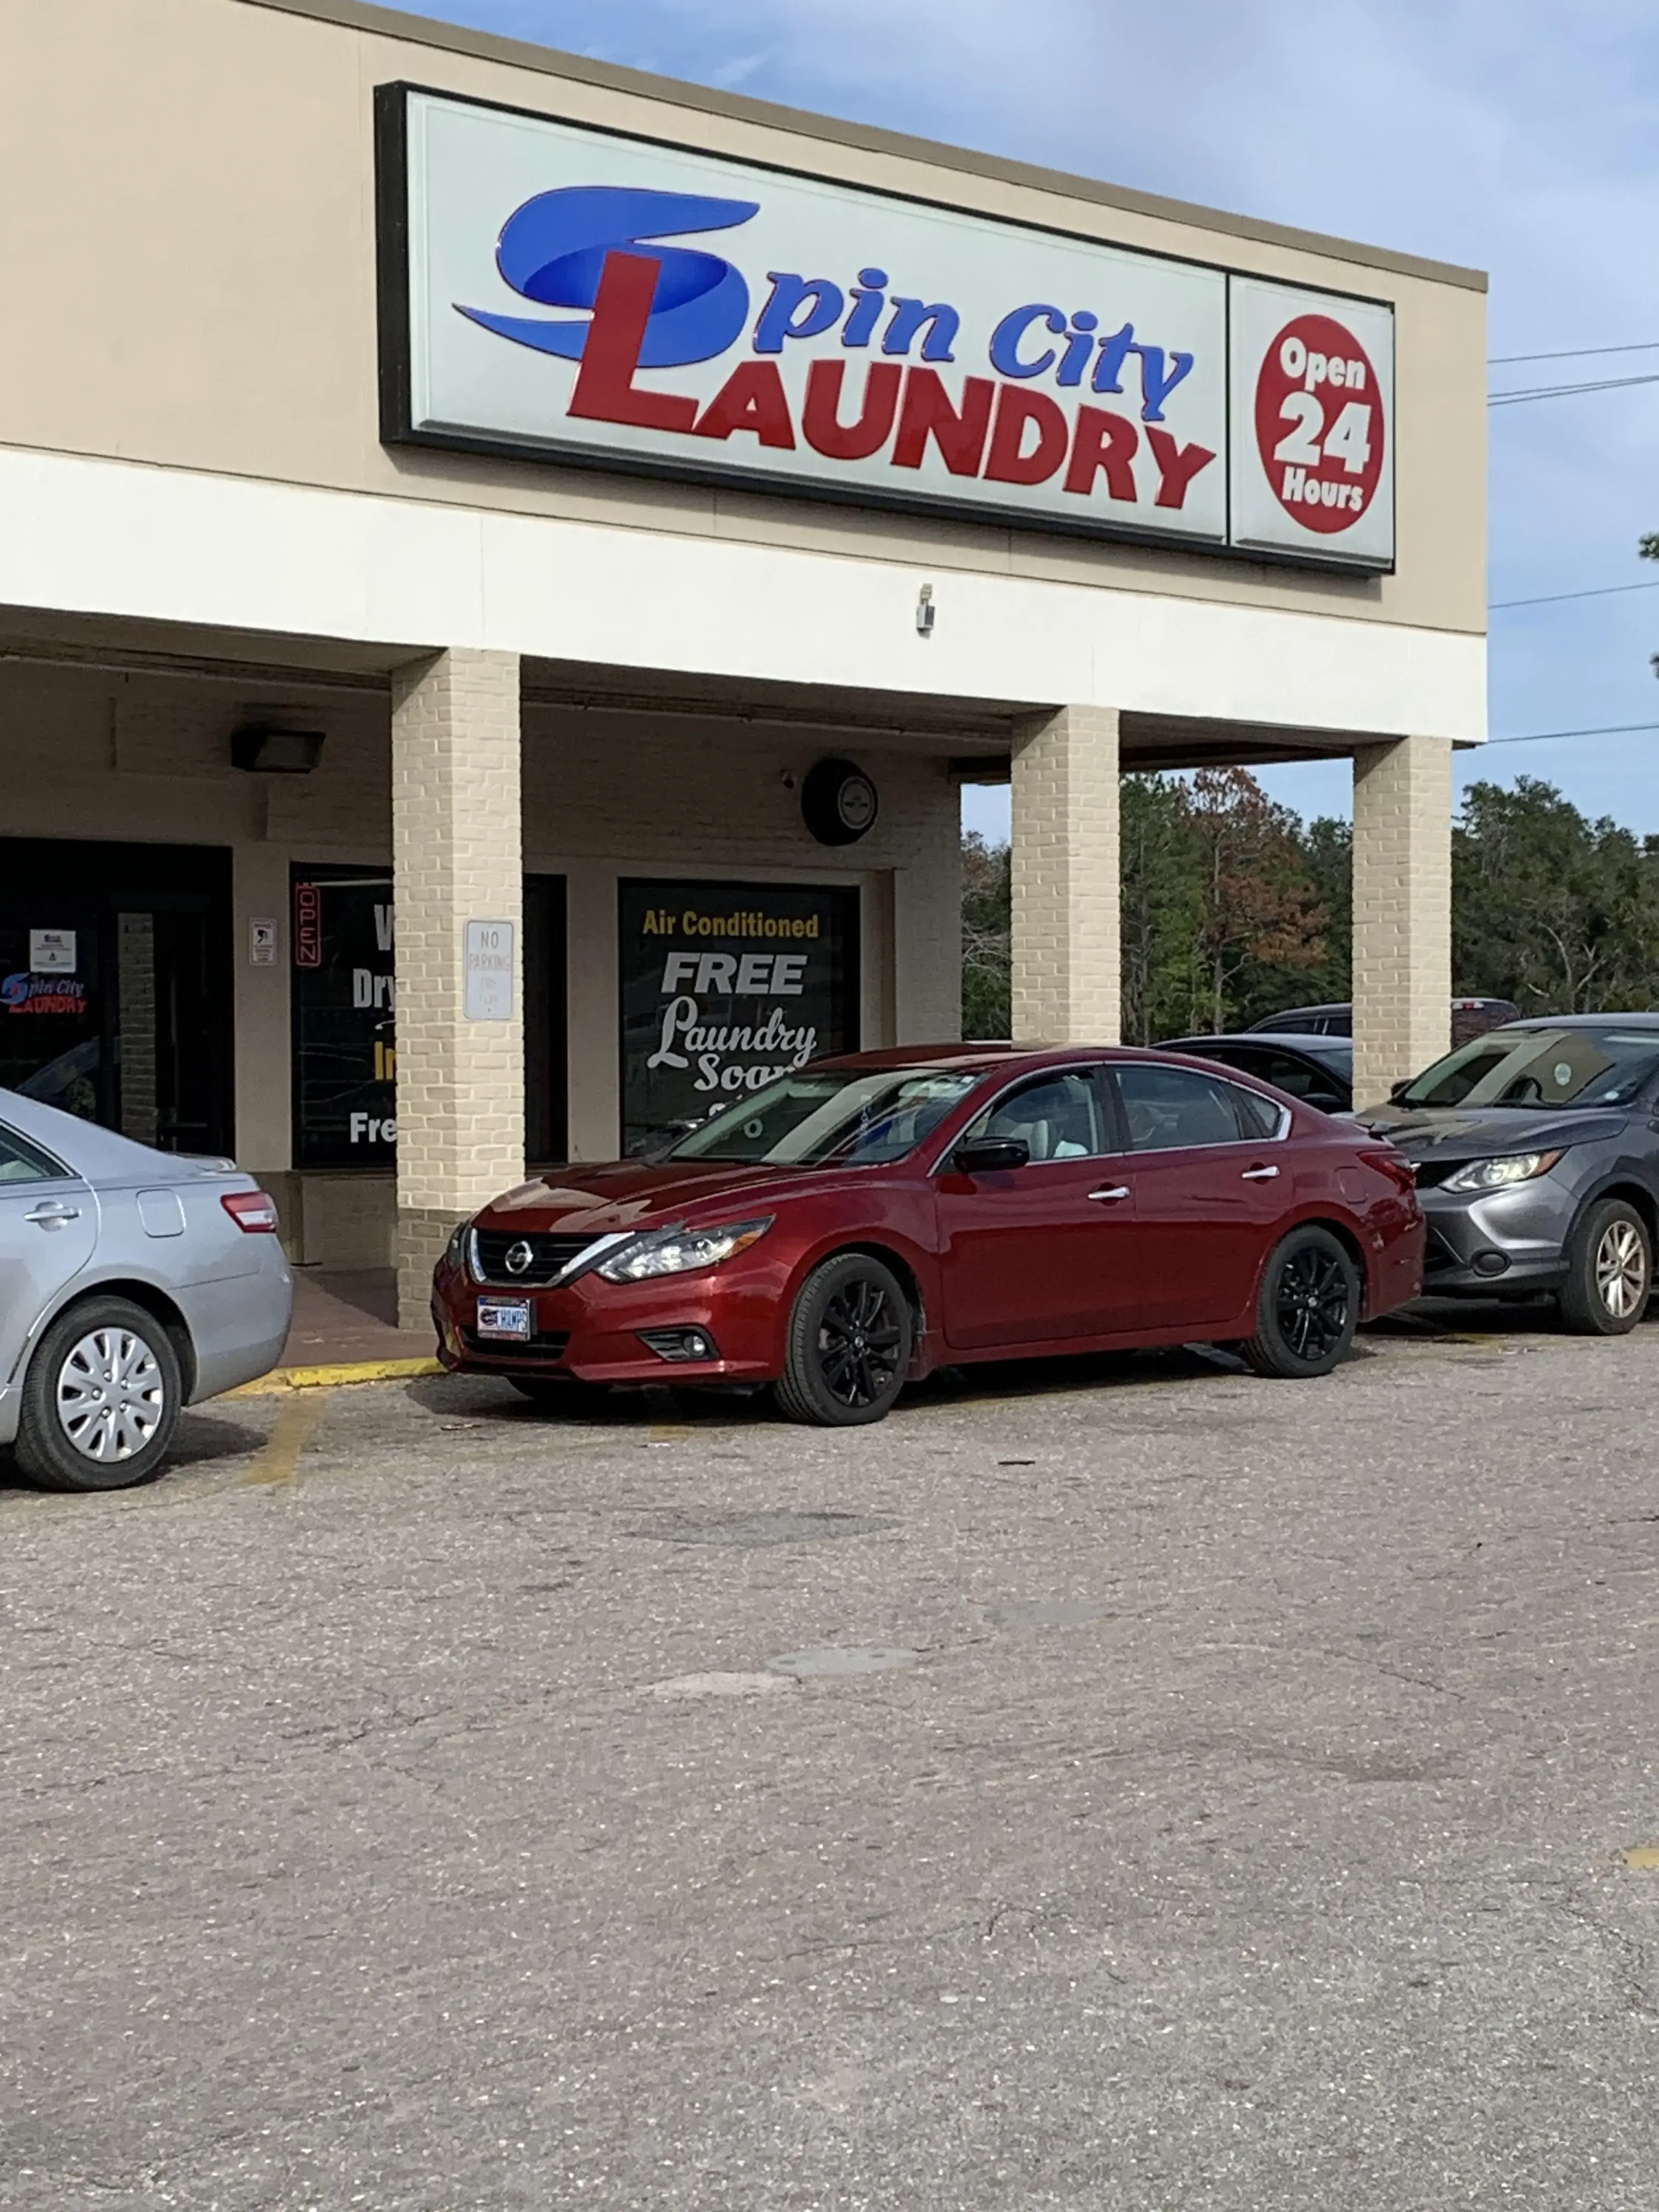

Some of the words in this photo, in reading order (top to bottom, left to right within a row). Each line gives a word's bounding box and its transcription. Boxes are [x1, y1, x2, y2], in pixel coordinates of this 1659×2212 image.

[566, 250, 1217, 509] LAUNDRY
[989, 303, 1193, 421] City
[1280, 336, 1365, 392] Open
[1273, 391, 1372, 474] 24
[1282, 466, 1363, 511] Hours
[300, 891, 316, 961] OPEN
[481, 931, 499, 949] NO
[643, 909, 676, 935] Air
[682, 911, 820, 938] Conditioned
[661, 952, 808, 995] FREE
[647, 995, 817, 1069] Laundry
